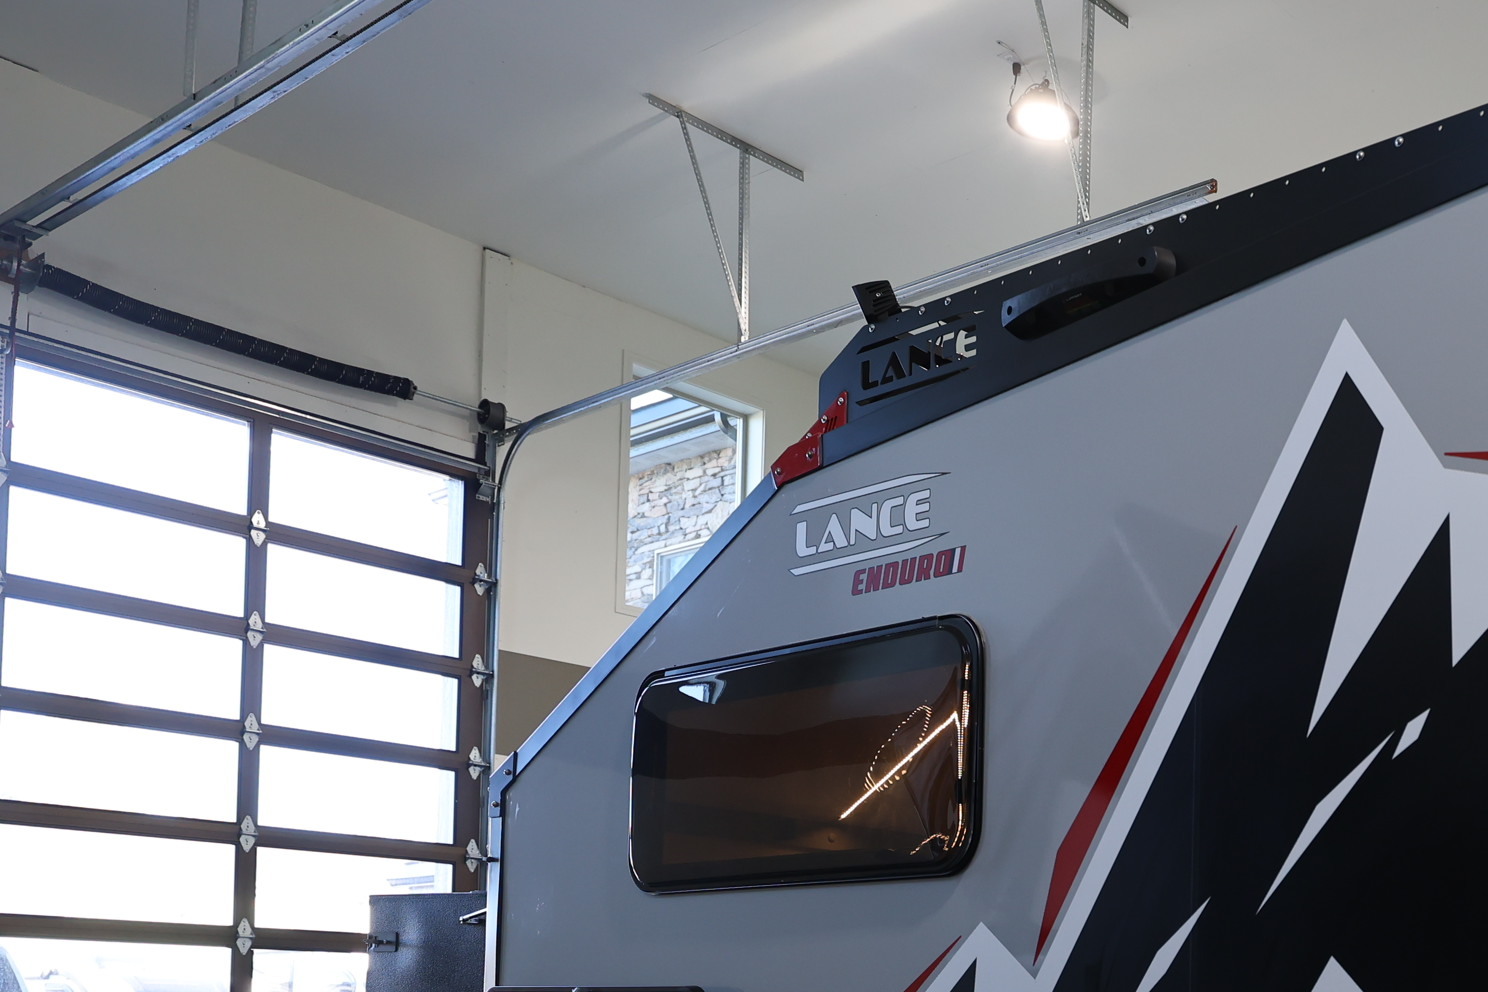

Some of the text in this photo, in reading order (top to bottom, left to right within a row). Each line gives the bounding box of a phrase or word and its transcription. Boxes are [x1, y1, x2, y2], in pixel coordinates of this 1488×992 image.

[861, 324, 977, 391] LANCE
[795, 488, 932, 559] LANCE
[851, 548, 960, 596] ENDURO
